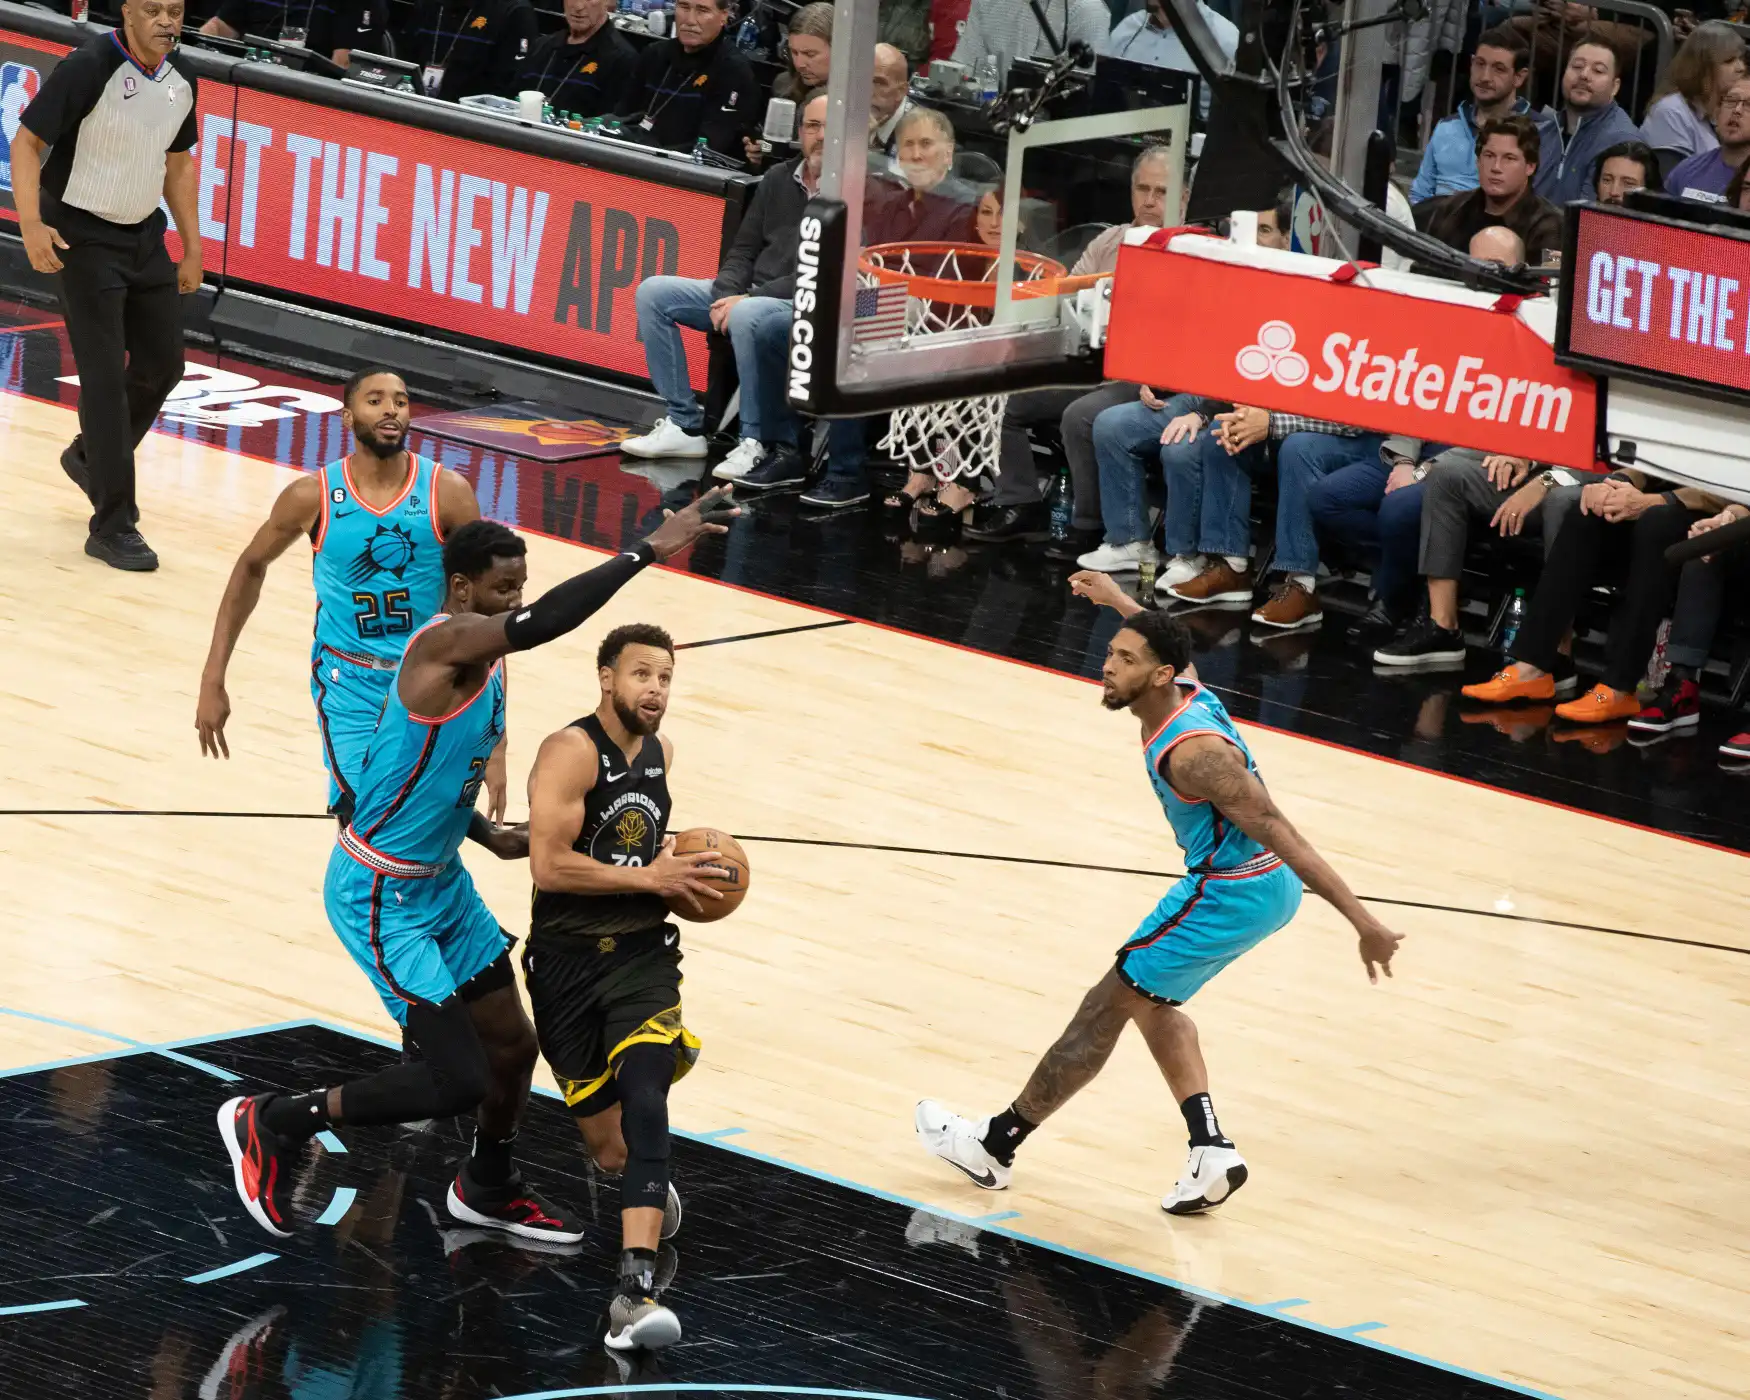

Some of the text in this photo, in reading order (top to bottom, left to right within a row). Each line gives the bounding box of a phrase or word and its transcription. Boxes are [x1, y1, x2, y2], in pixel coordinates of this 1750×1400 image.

[160, 114, 272, 248] ET
[286, 133, 398, 281] THE
[407, 163, 550, 315] NEW
[789, 216, 822, 401] SUNS.COM
[1586, 251, 1661, 333] GET
[1668, 266, 1739, 351] THE
[333, 488, 345, 503] 6
[403, 508, 428, 517] PayPal
[352, 587, 413, 639] 25
[602, 754, 611, 768] 6
[599, 792, 662, 821] WARRIORS
